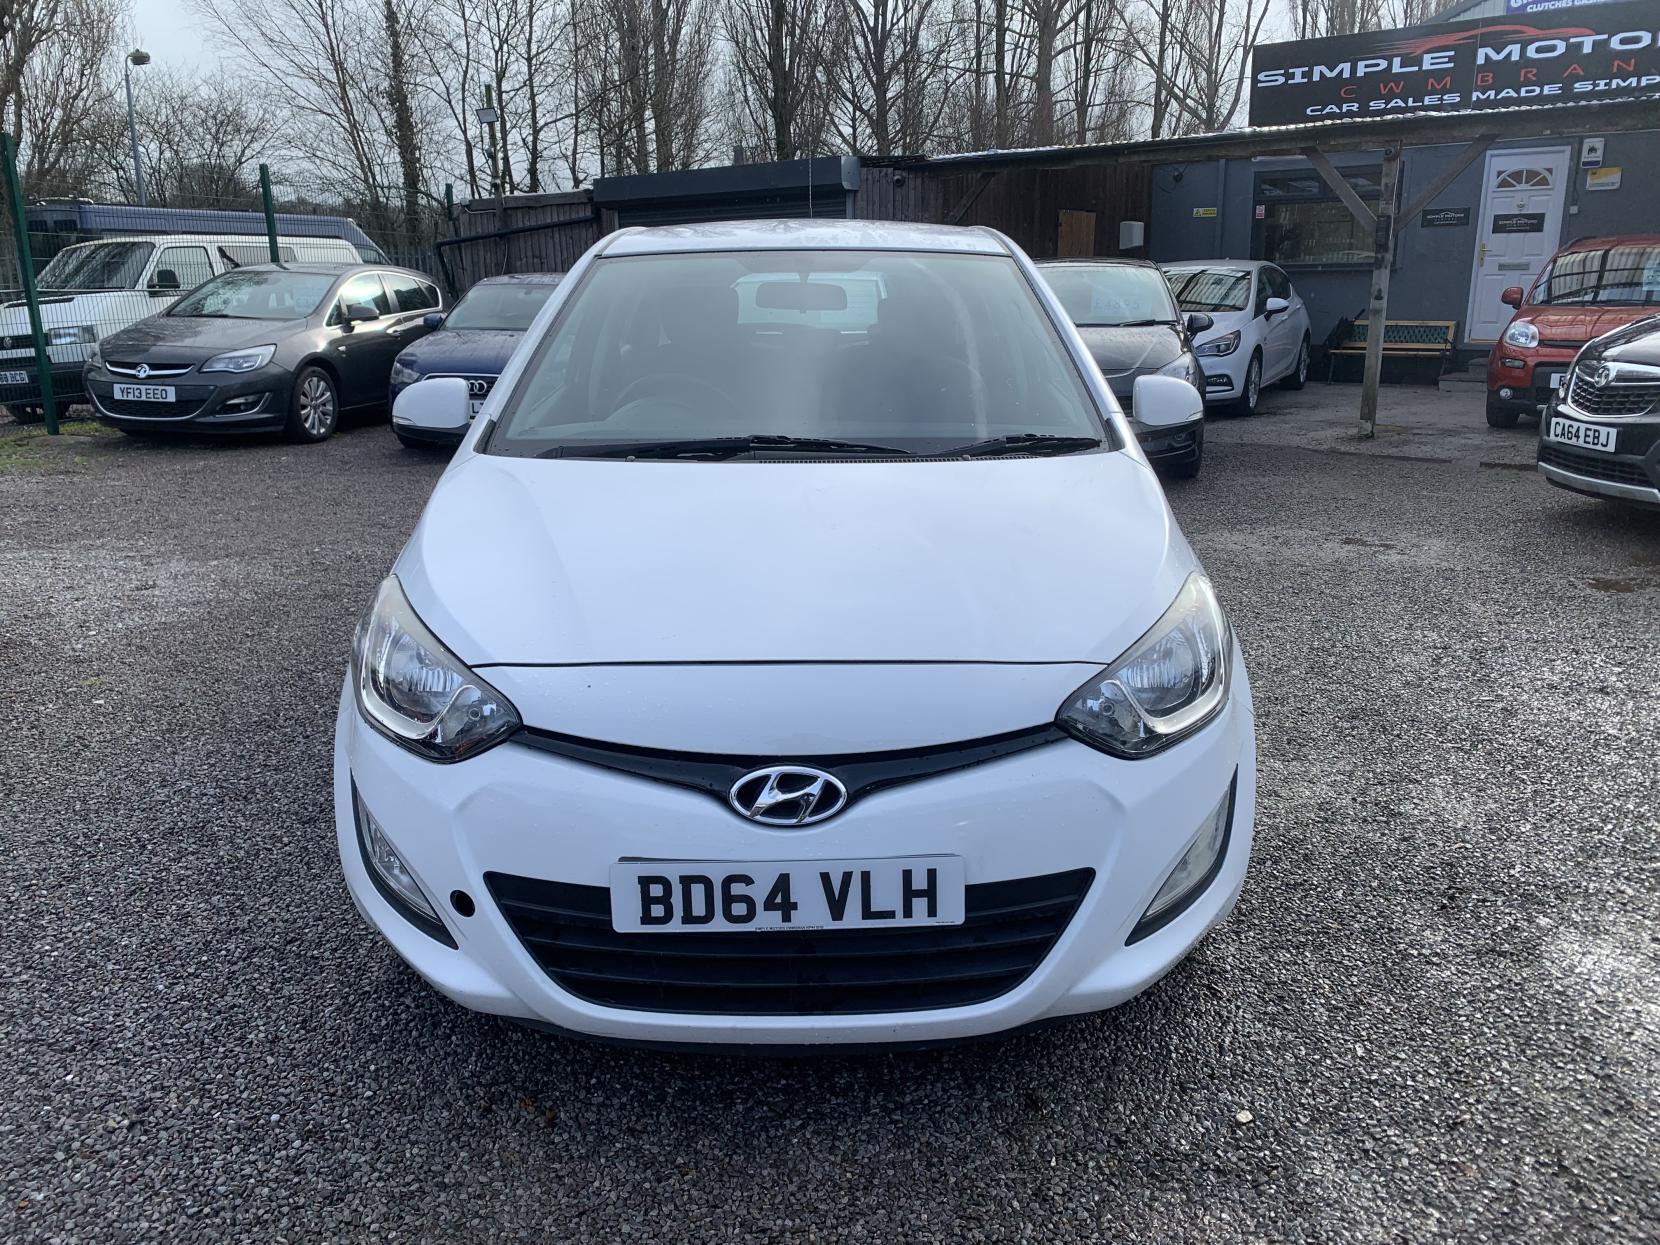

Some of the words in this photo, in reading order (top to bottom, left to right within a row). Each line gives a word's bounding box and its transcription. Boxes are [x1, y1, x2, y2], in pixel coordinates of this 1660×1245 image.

[1526, 0, 1573, 12] CLUTCHES
[1257, 50, 1456, 88] SIMPLE
[1476, 30, 1660, 65] MOTO
[1306, 102, 1360, 116] CAR
[1368, 92, 1461, 110] SALES
[1471, 83, 1563, 101] MADE
[119, 386, 143, 399] YF13
[145, 388, 168, 400] EEO
[1553, 421, 1581, 441] CA64
[1583, 427, 1610, 448] EBJ
[637, 872, 798, 926] BD64
[819, 868, 938, 922] VLH
